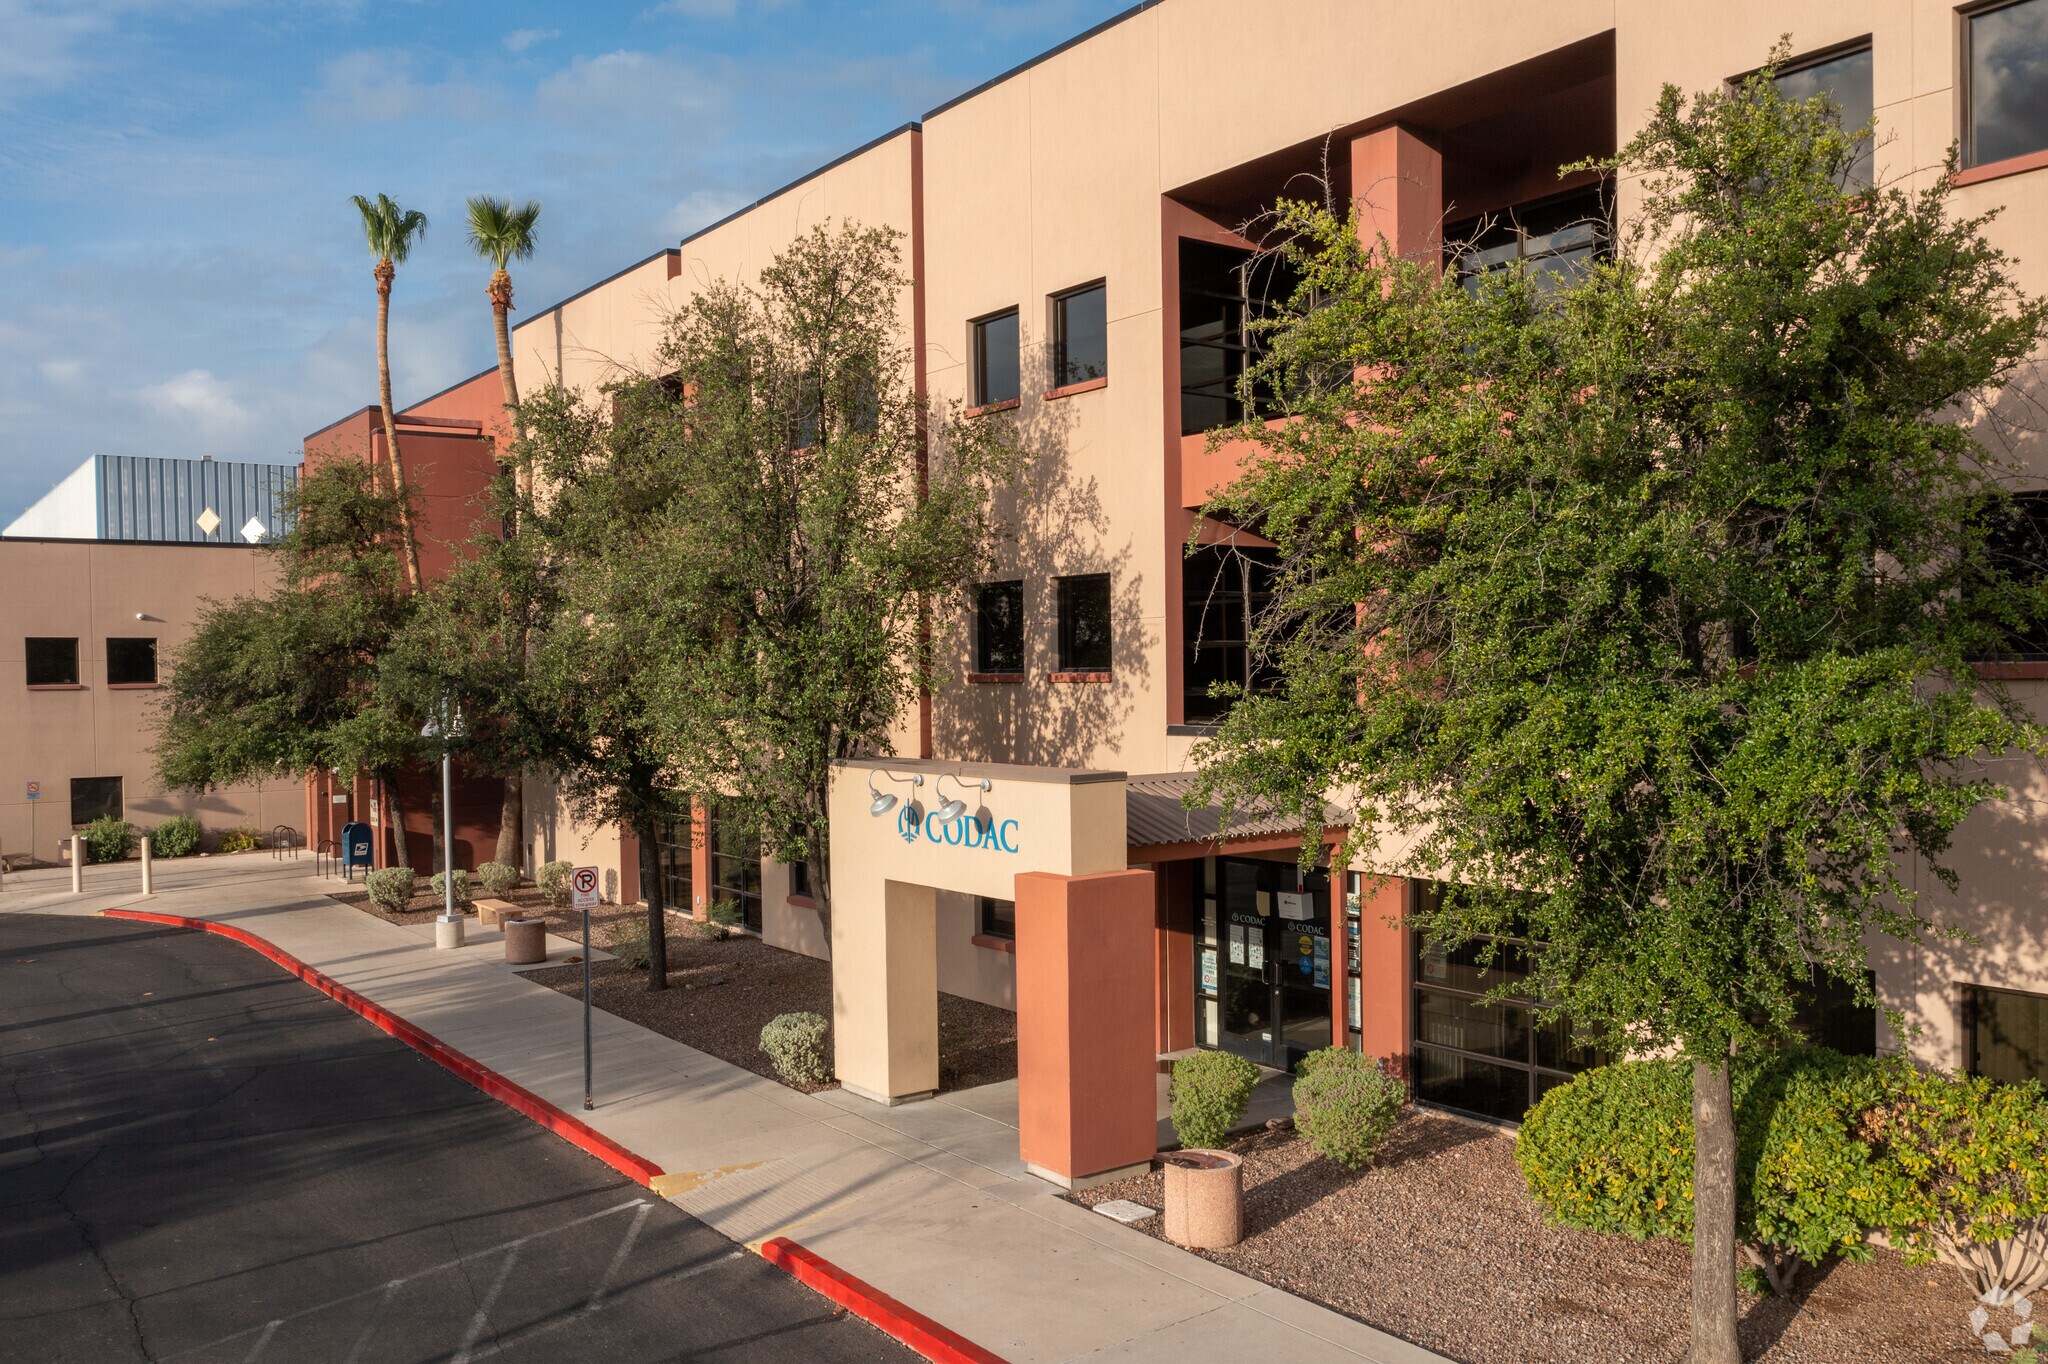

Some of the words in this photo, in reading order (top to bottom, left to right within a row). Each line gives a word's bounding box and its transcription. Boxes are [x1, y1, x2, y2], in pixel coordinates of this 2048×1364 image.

[925, 811, 1019, 853] CODAC
[1240, 914, 1266, 926] CODAC
[1296, 924, 1324, 935] CODAC
